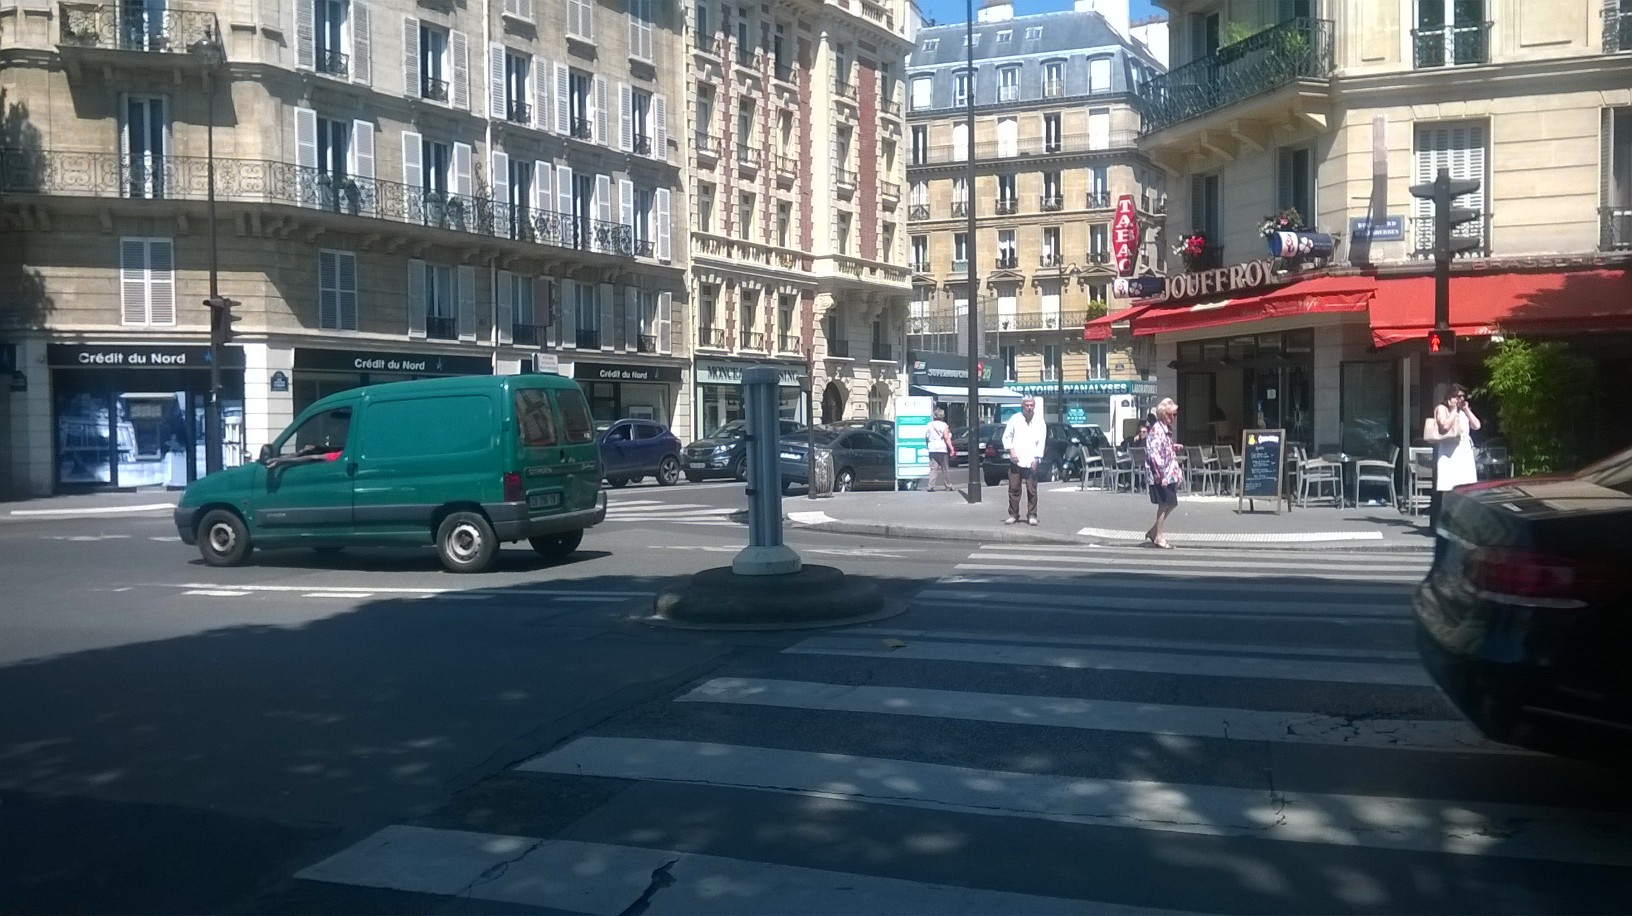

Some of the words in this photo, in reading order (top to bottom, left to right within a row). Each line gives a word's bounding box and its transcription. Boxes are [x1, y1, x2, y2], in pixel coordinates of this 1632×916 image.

[1115, 199, 1135, 272] TABAC
[1472, 254, 1606, 270] BRASSERIE
[1160, 258, 1275, 301] JOUFFROY
[79, 352, 123, 364] Crédit
[128, 353, 146, 364] du
[150, 353, 186, 364] Nord
[354, 358, 385, 369] Crédit
[387, 360, 400, 370] du
[402, 361, 425, 370] Nord
[599, 369, 620, 378] Crédit
[621, 371, 631, 379] du
[631, 371, 648, 379] Nord
[707, 366, 743, 381] MONCEA
[1063, 383, 1127, 395] D'ANALYSES
